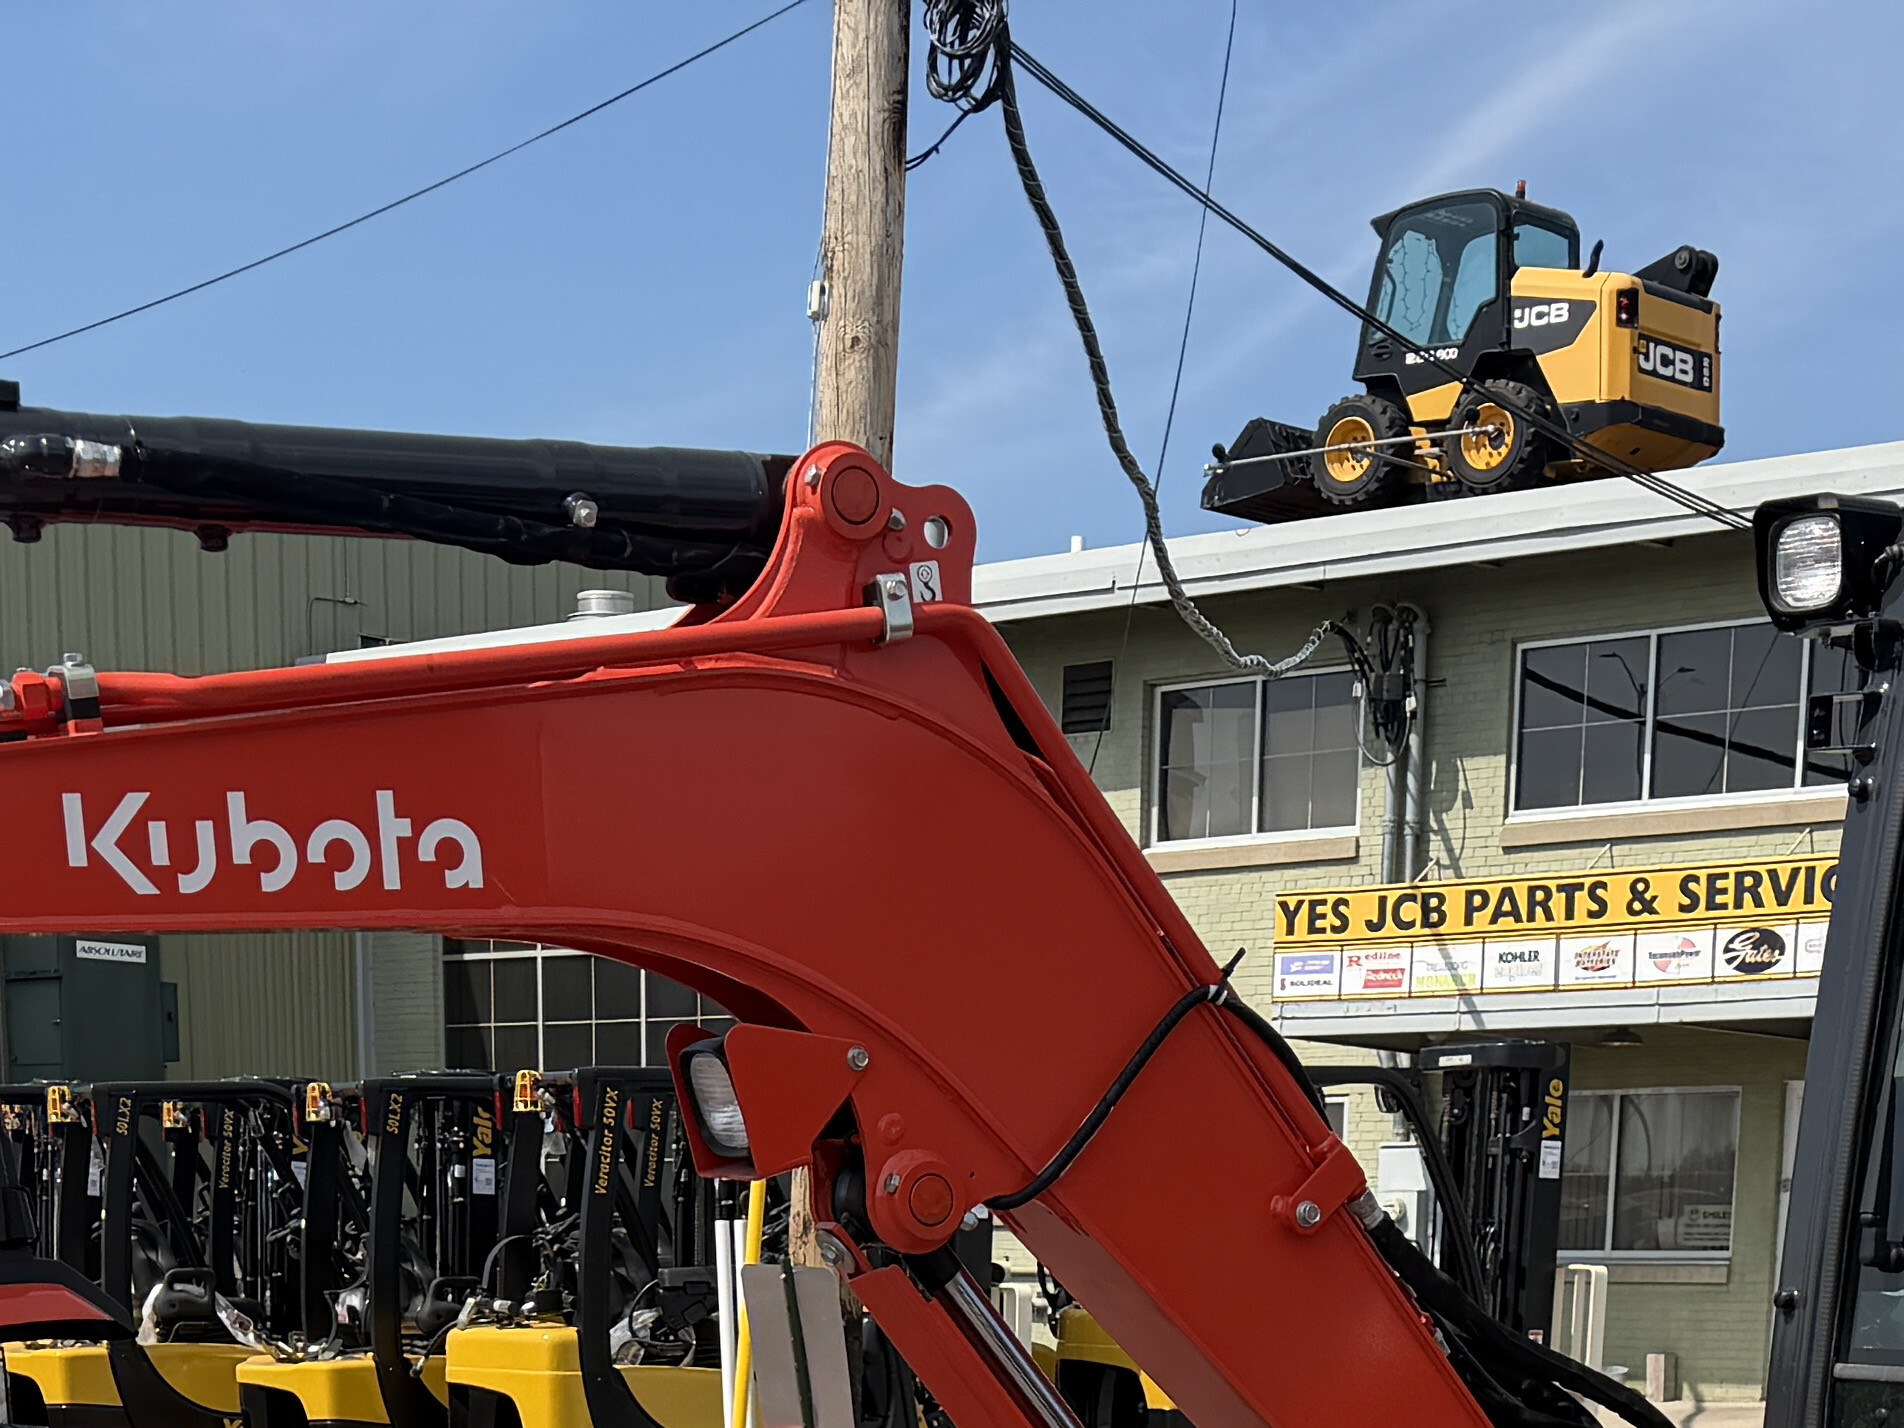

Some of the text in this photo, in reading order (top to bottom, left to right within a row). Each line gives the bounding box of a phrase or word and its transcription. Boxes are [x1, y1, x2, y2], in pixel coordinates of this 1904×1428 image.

[1513, 301, 1569, 330] JCB
[1639, 342, 1693, 383] JCB
[62, 789, 484, 895] Kubota
[1278, 896, 1350, 936] YES
[1365, 891, 1447, 933] JCB
[1464, 880, 1609, 927] PARTS
[1626, 877, 1660, 917] &
[1498, 950, 1540, 964] KOHLER
[1728, 932, 1782, 968] Gates
[1542, 1078, 1564, 1138] Yale
[595, 1129, 614, 1194] Veracitor
[644, 1133, 659, 1187] Veracitor
